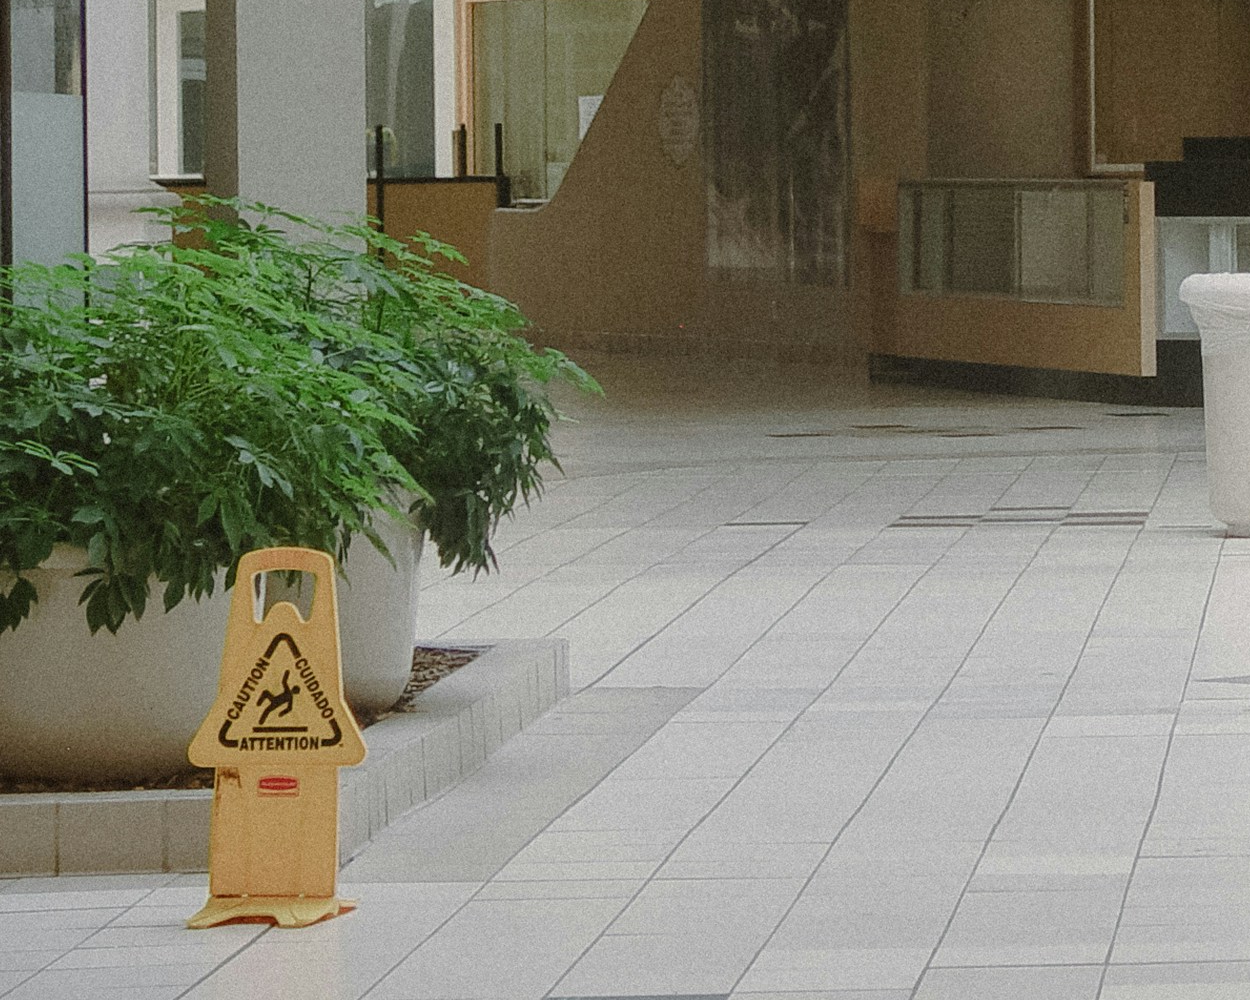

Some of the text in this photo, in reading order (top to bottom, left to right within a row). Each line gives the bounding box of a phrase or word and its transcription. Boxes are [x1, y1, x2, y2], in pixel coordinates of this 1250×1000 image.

[227, 656, 271, 721] CAUTION
[294, 657, 335, 720] CUIDADO
[239, 736, 320, 751] ATTENTION
